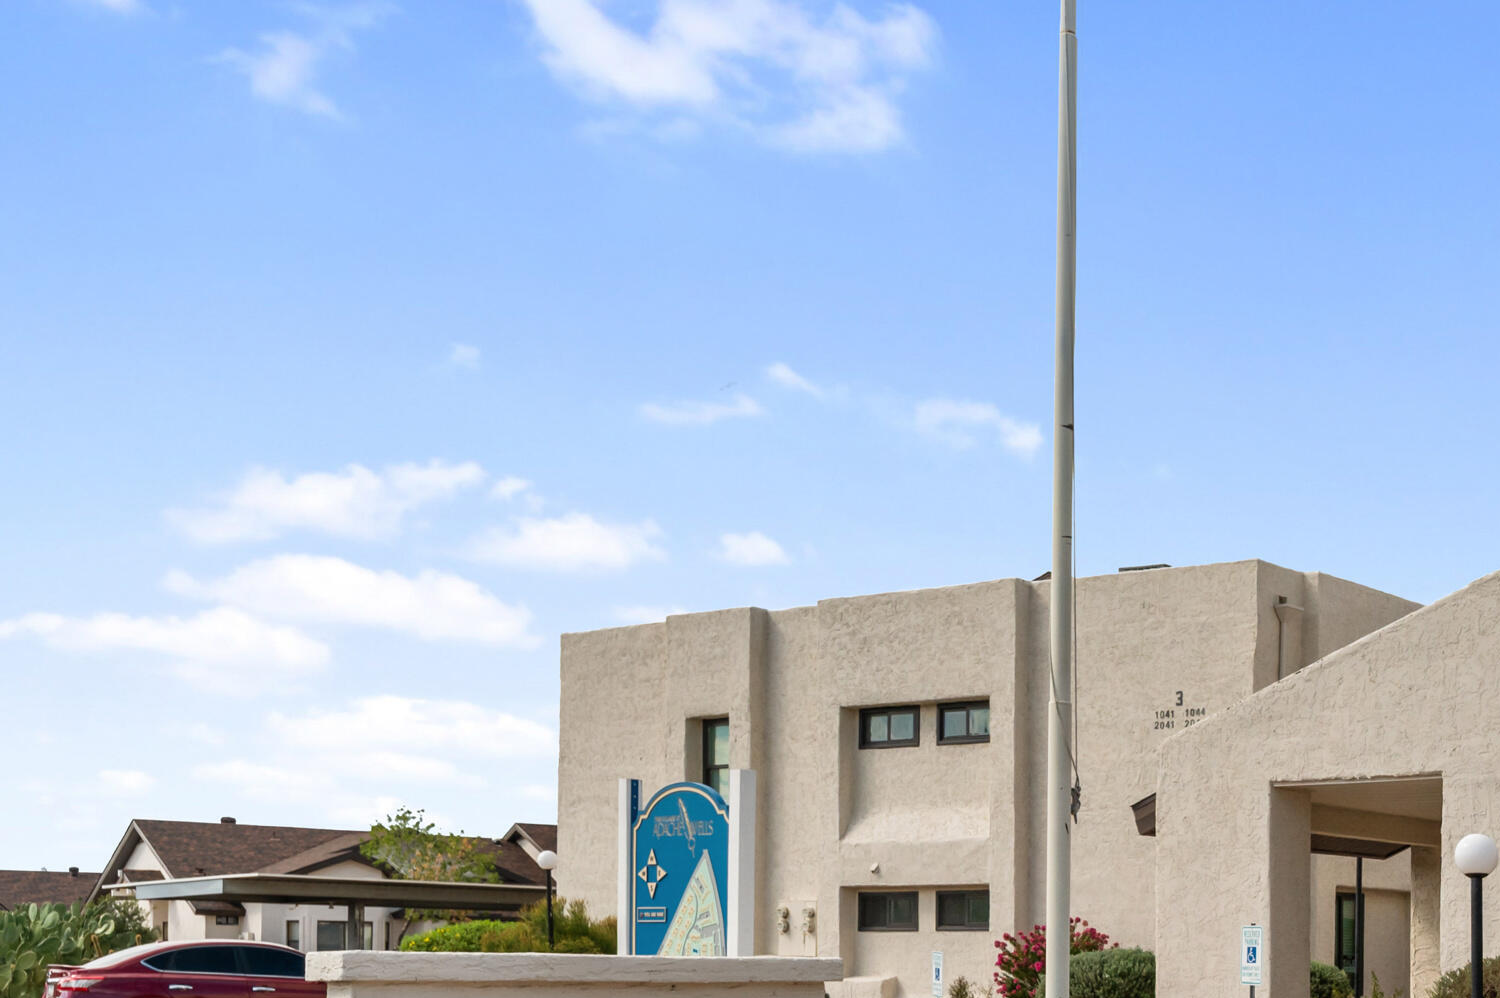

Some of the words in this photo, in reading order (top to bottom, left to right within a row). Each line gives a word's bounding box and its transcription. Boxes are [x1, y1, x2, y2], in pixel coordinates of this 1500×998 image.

[1175, 690, 1184, 707] 3
[1154, 709, 1175, 719] 1041
[1153, 720, 1175, 730] 2041
